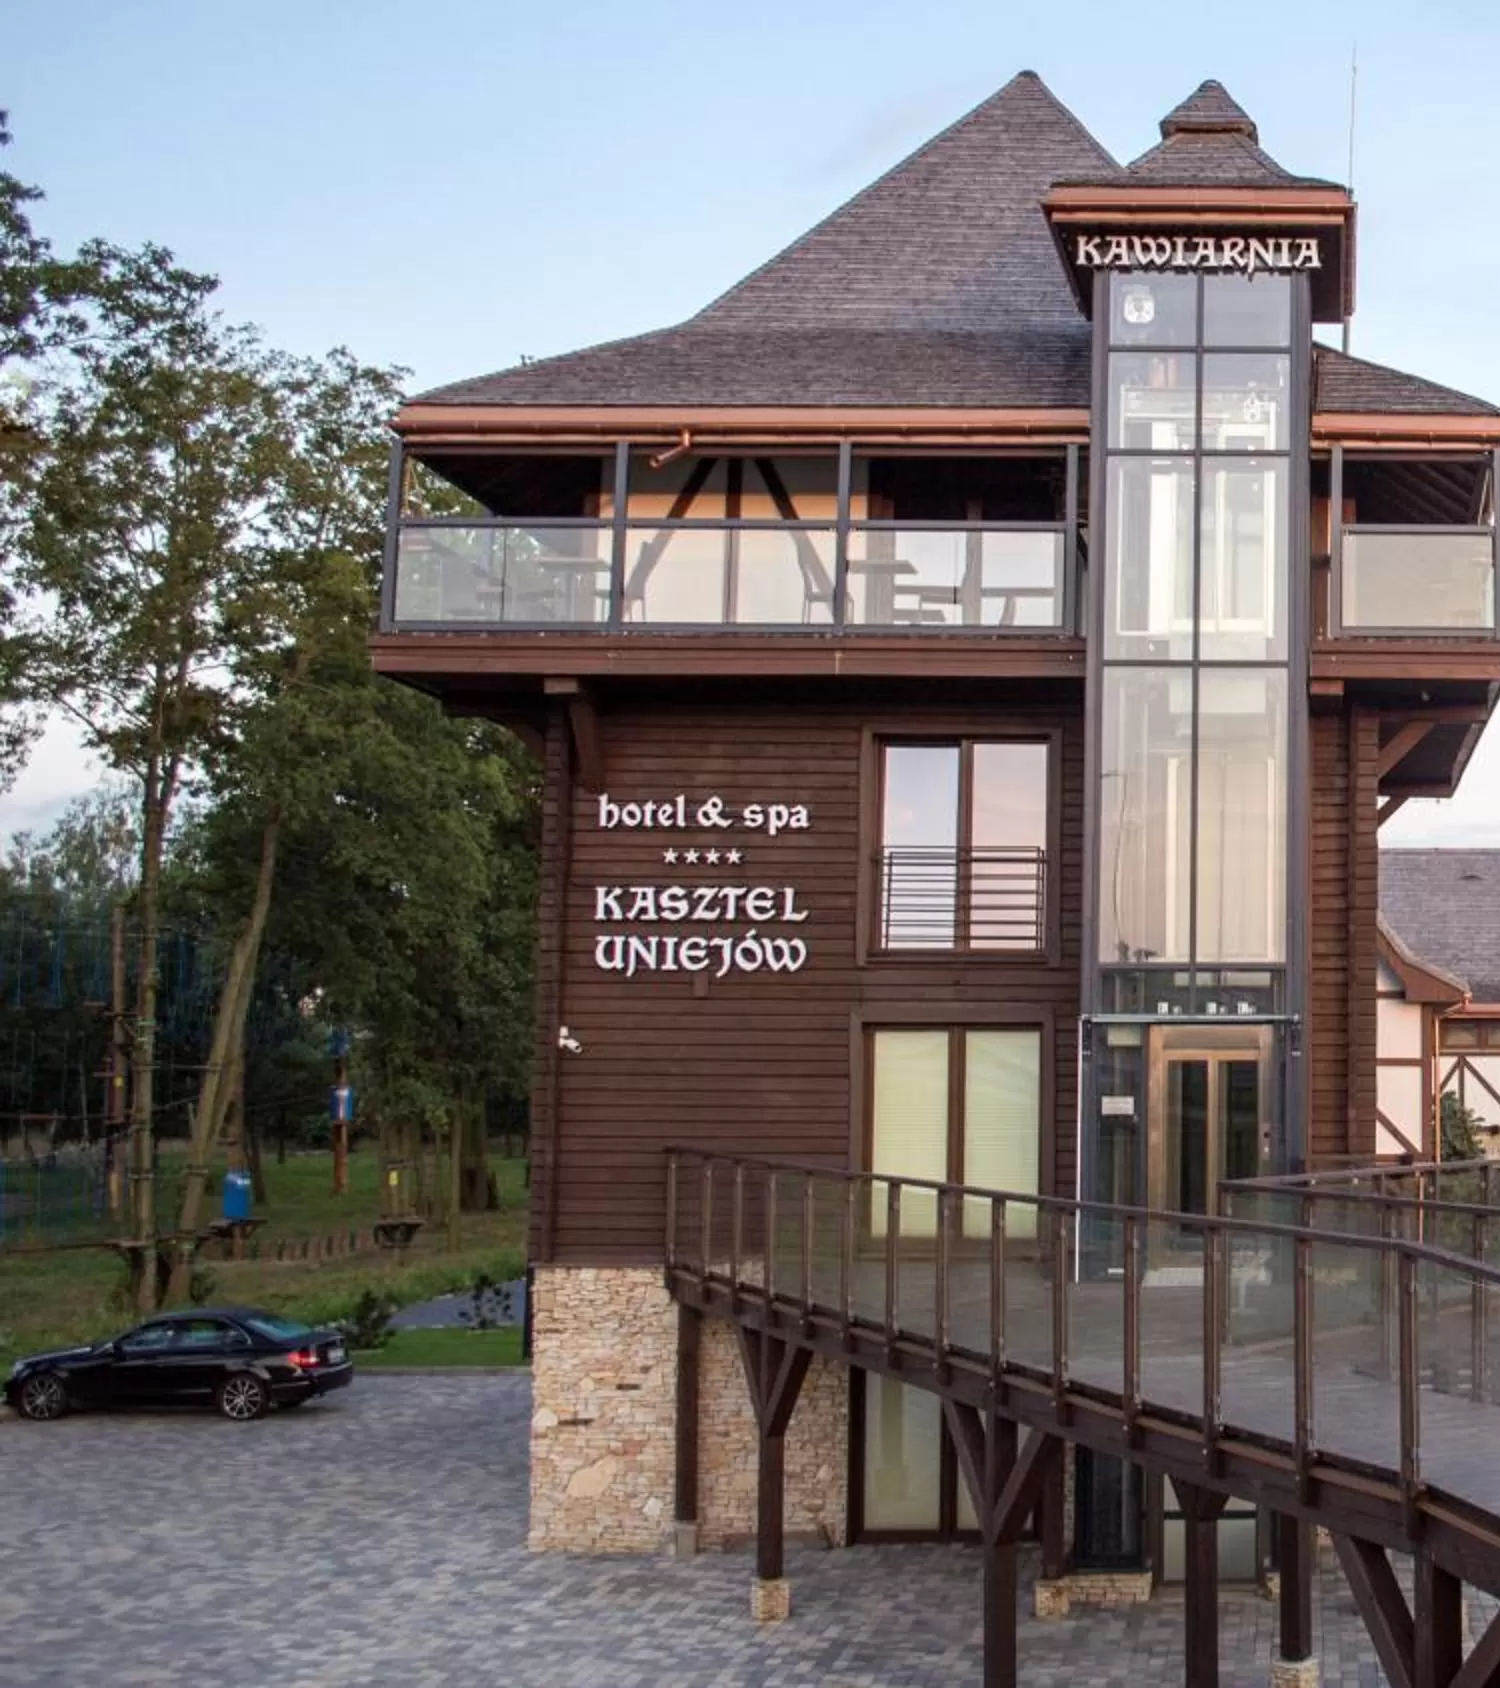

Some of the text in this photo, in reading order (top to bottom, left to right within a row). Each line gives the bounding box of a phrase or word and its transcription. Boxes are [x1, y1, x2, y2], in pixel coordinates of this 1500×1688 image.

[1075, 235, 1322, 272] KAWIARNIA
[598, 793, 810, 835] hotel & spa
[595, 886, 808, 921] KASZTEL
[595, 929, 807, 977] UNIEJÓW
